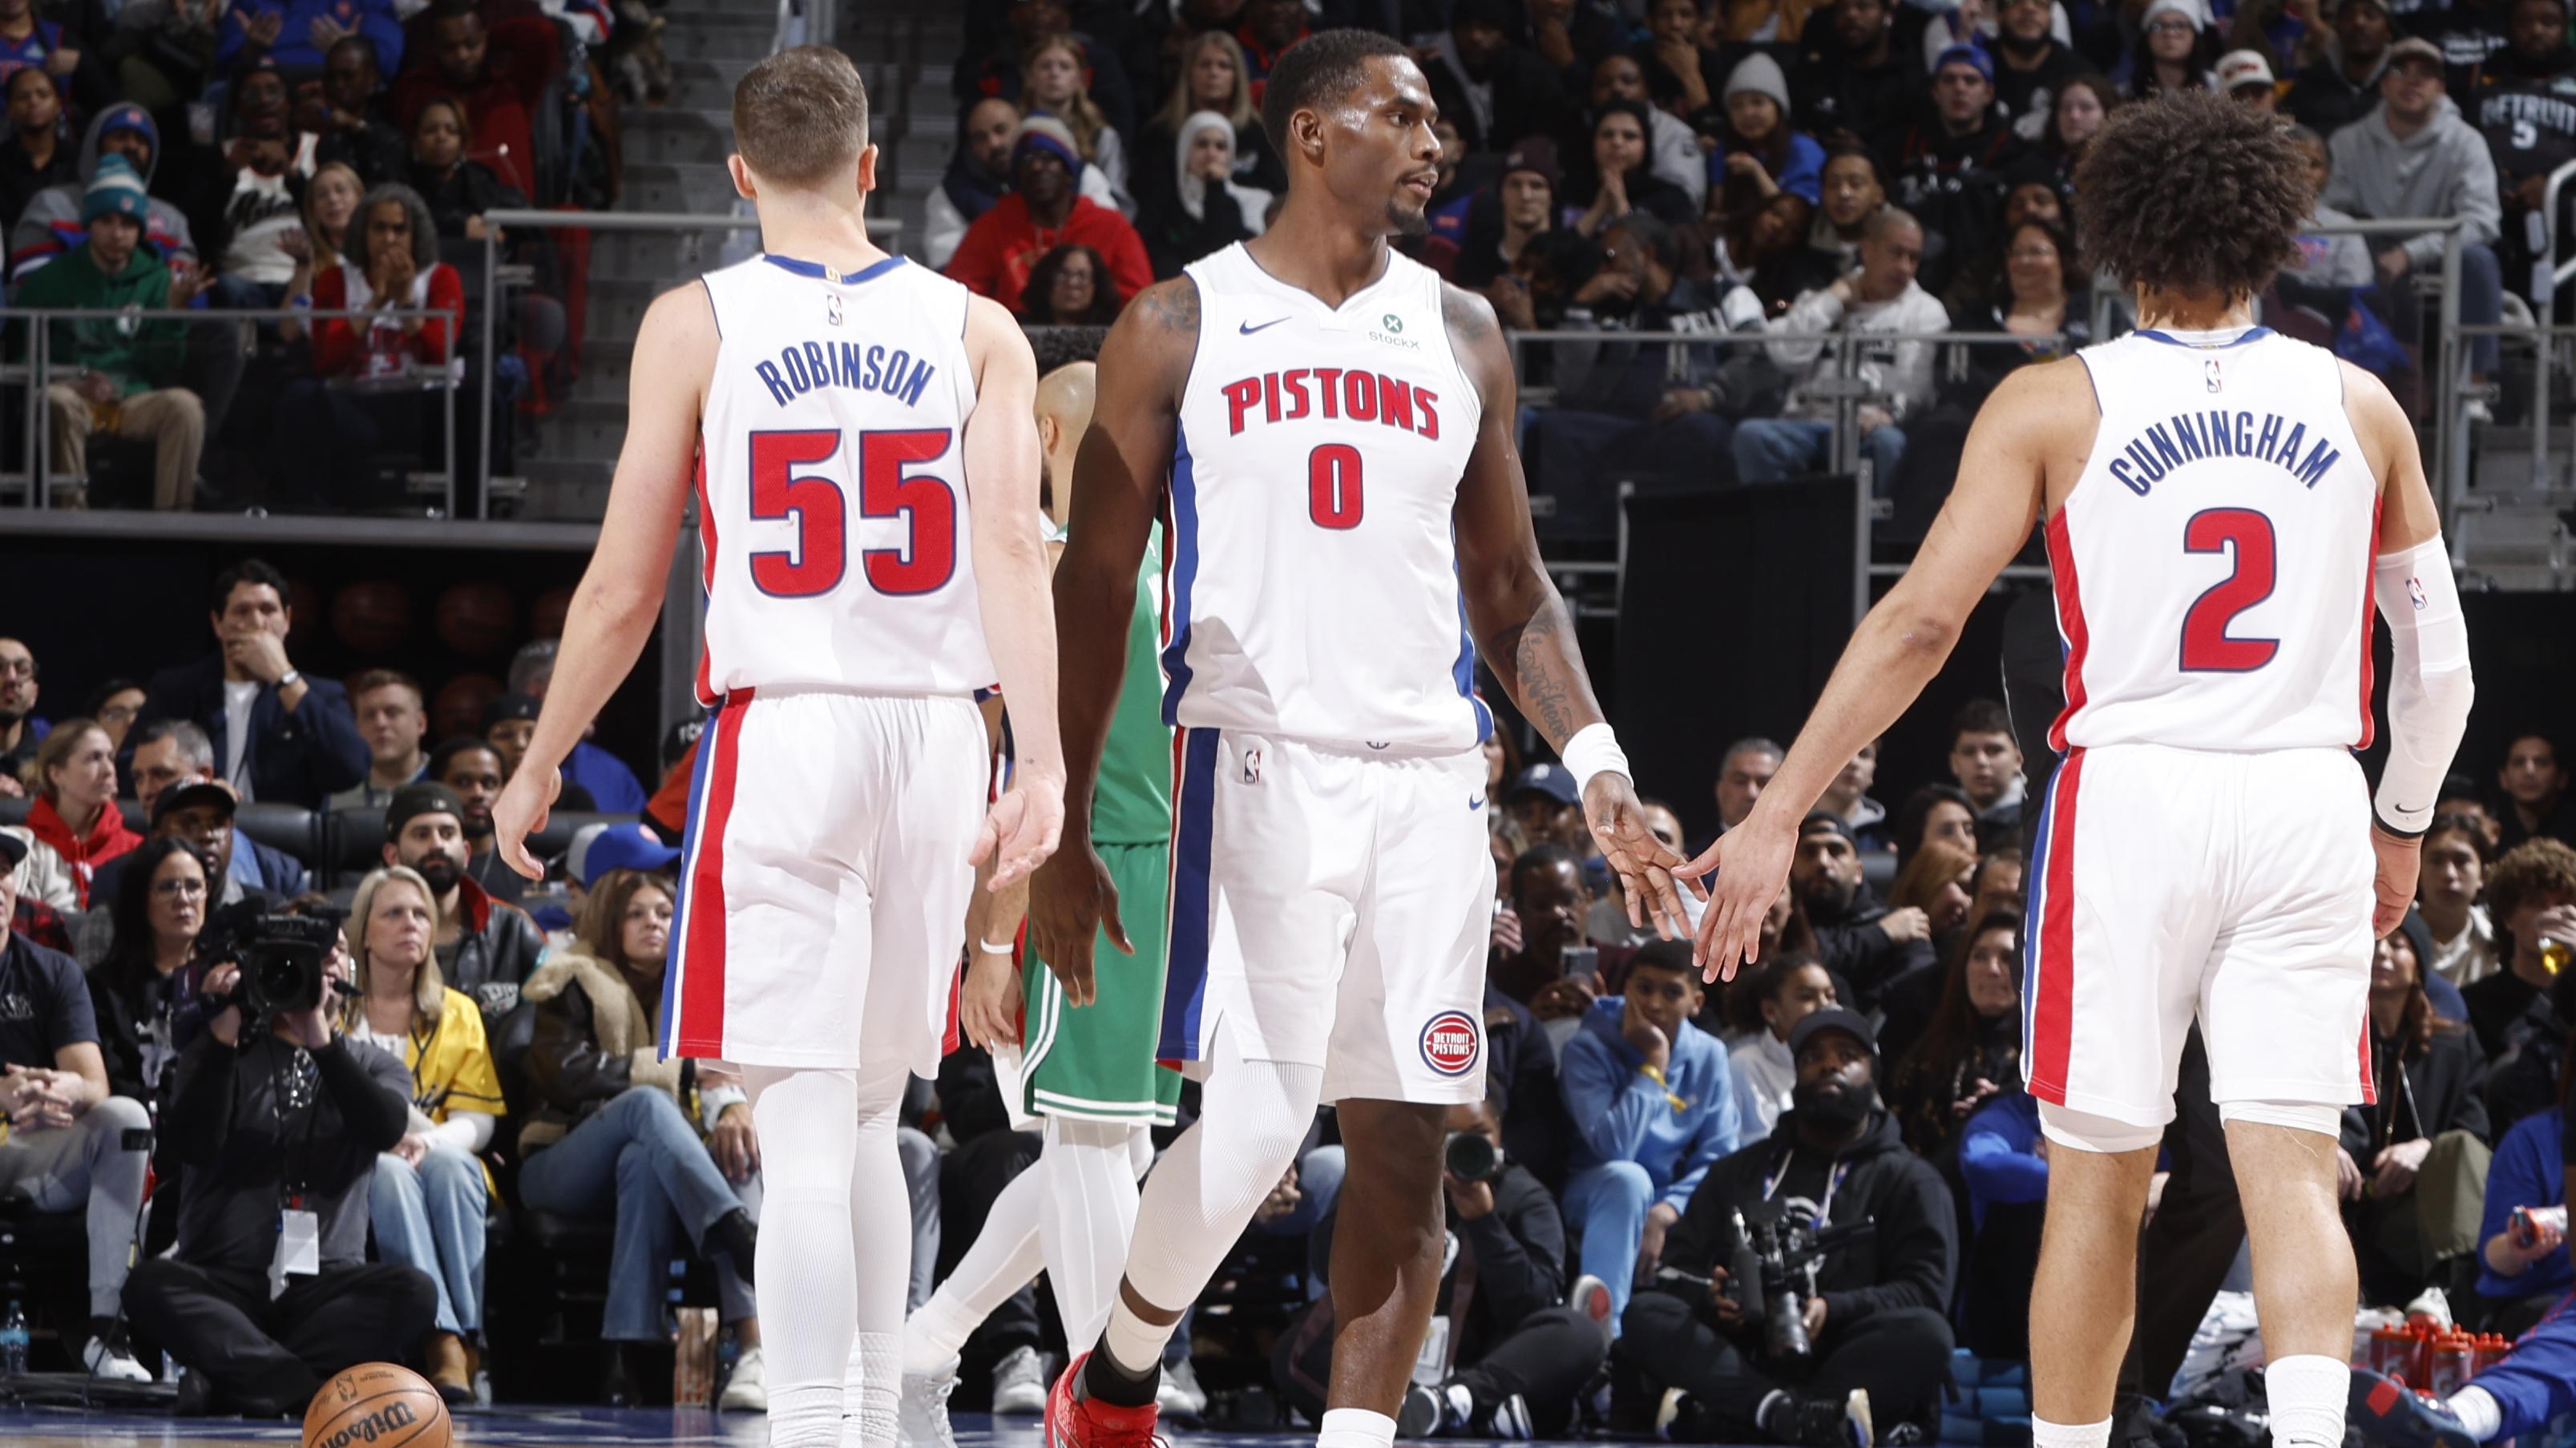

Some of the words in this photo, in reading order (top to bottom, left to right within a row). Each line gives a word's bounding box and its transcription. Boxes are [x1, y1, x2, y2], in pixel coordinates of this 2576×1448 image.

[755, 341, 935, 408] ROBINSON
[1369, 331, 1420, 351] StockX
[1221, 368, 1439, 442] PISTONS
[1308, 443, 1364, 530] 0
[2109, 410, 2341, 497] CUNNINGHAM
[749, 428, 958, 599] 55
[2178, 506, 2281, 672] 2
[1432, 1032, 1470, 1044] DETROIT
[1432, 1043, 1470, 1055] PISTONS
